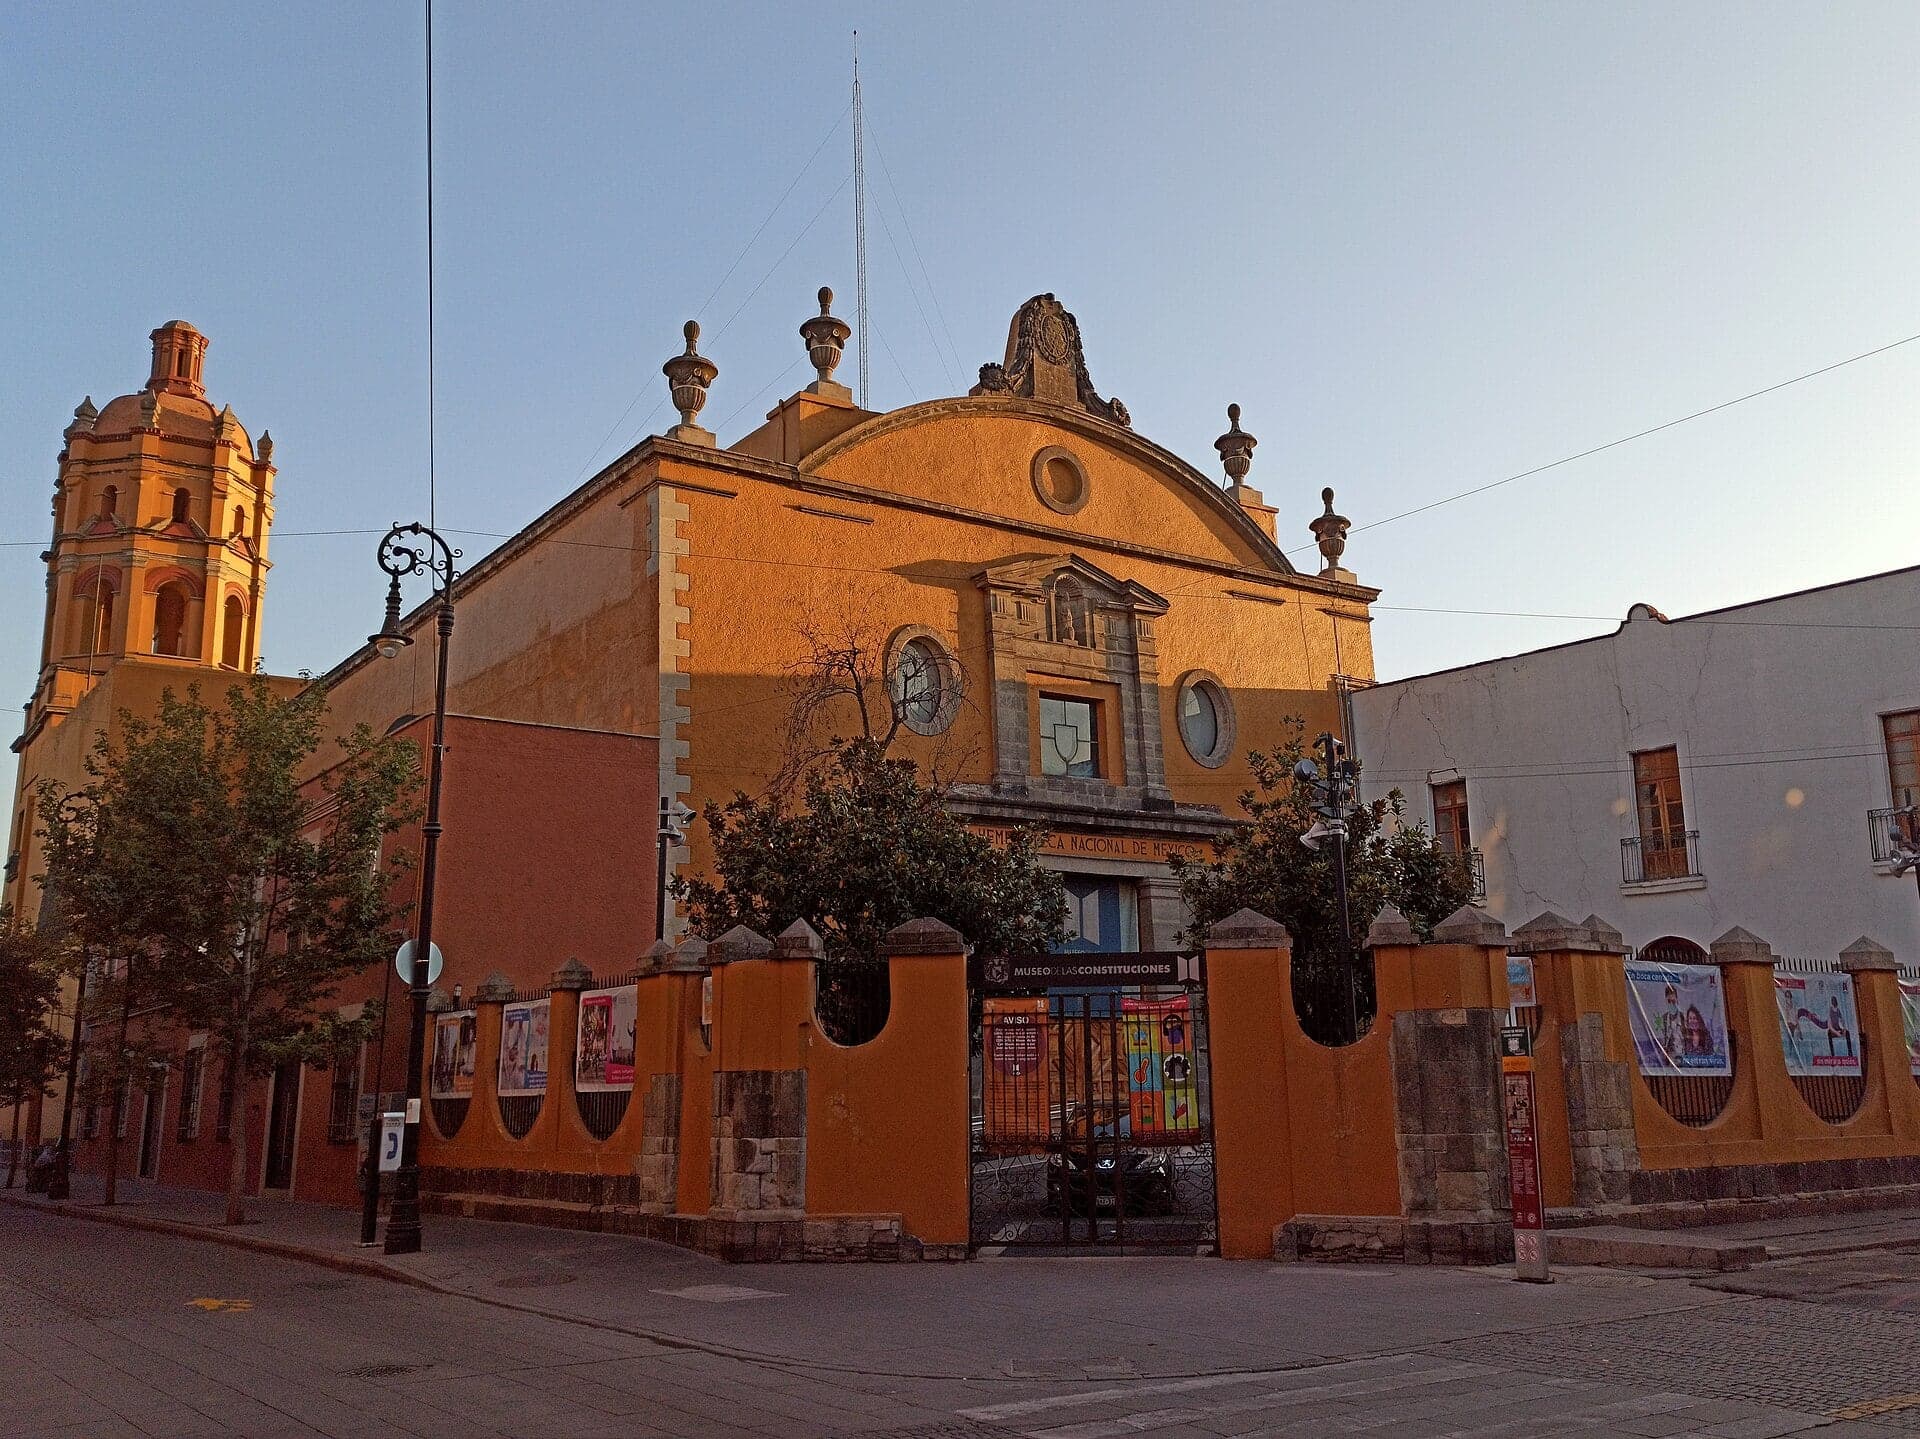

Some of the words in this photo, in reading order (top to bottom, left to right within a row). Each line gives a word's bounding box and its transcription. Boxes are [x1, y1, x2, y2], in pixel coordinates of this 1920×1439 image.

[1071, 836, 1127, 855] NACIONAL
[1133, 840, 1147, 856] DE
[1003, 1016, 1030, 1024] AVISO
